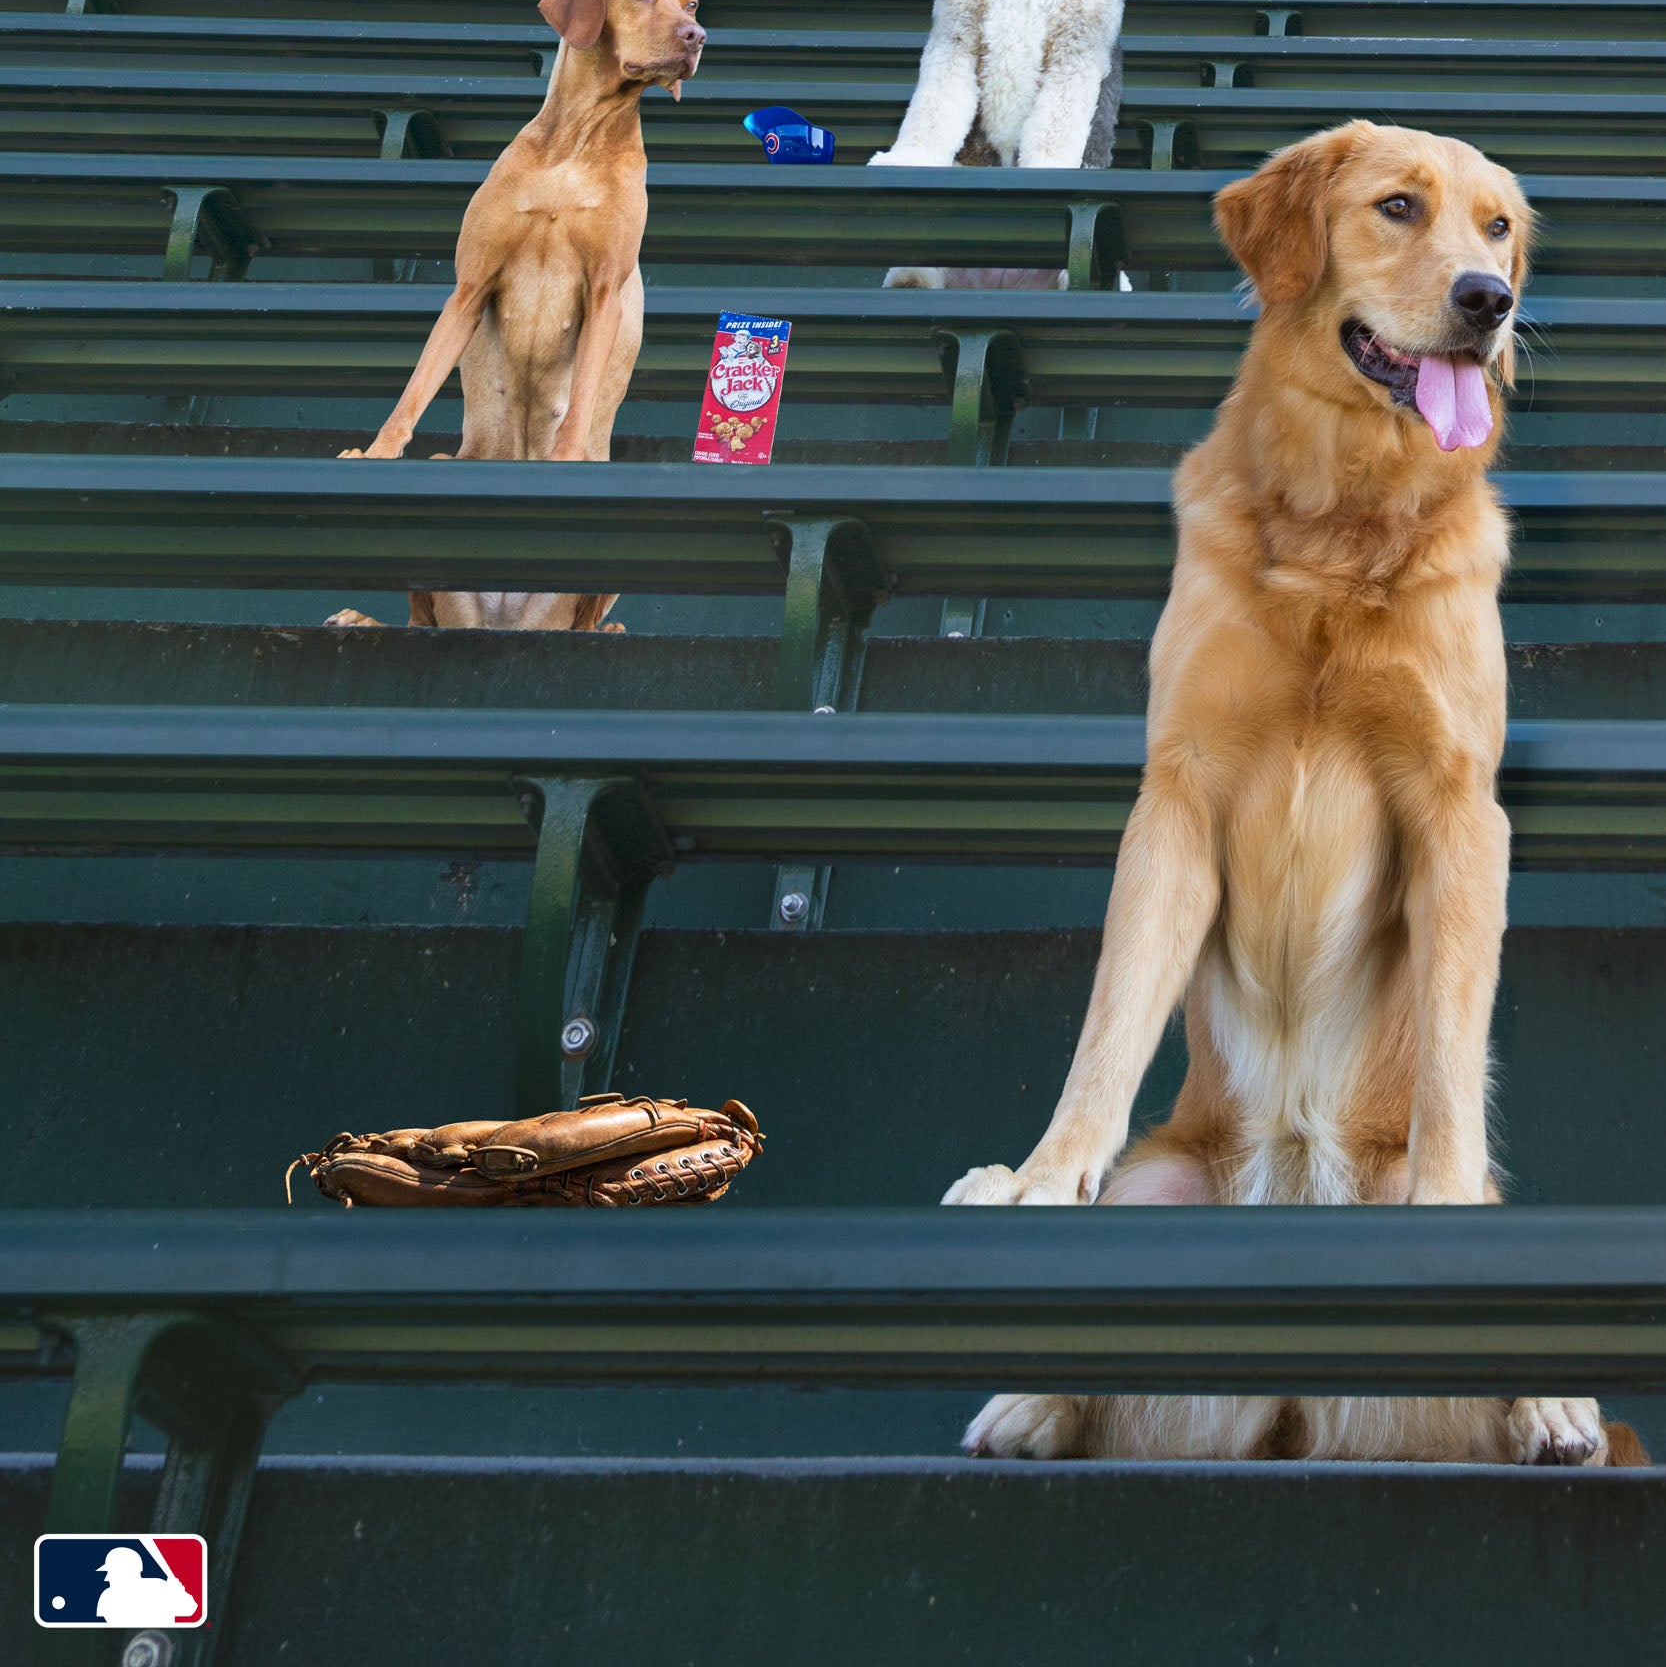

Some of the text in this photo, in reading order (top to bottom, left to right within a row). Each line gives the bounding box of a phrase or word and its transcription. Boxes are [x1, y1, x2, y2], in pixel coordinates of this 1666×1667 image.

[725, 321, 783, 329] PRIZE INSIDE!
[770, 335, 779, 348] 3
[711, 363, 781, 379] Cracker
[720, 378, 764, 396] Jack
